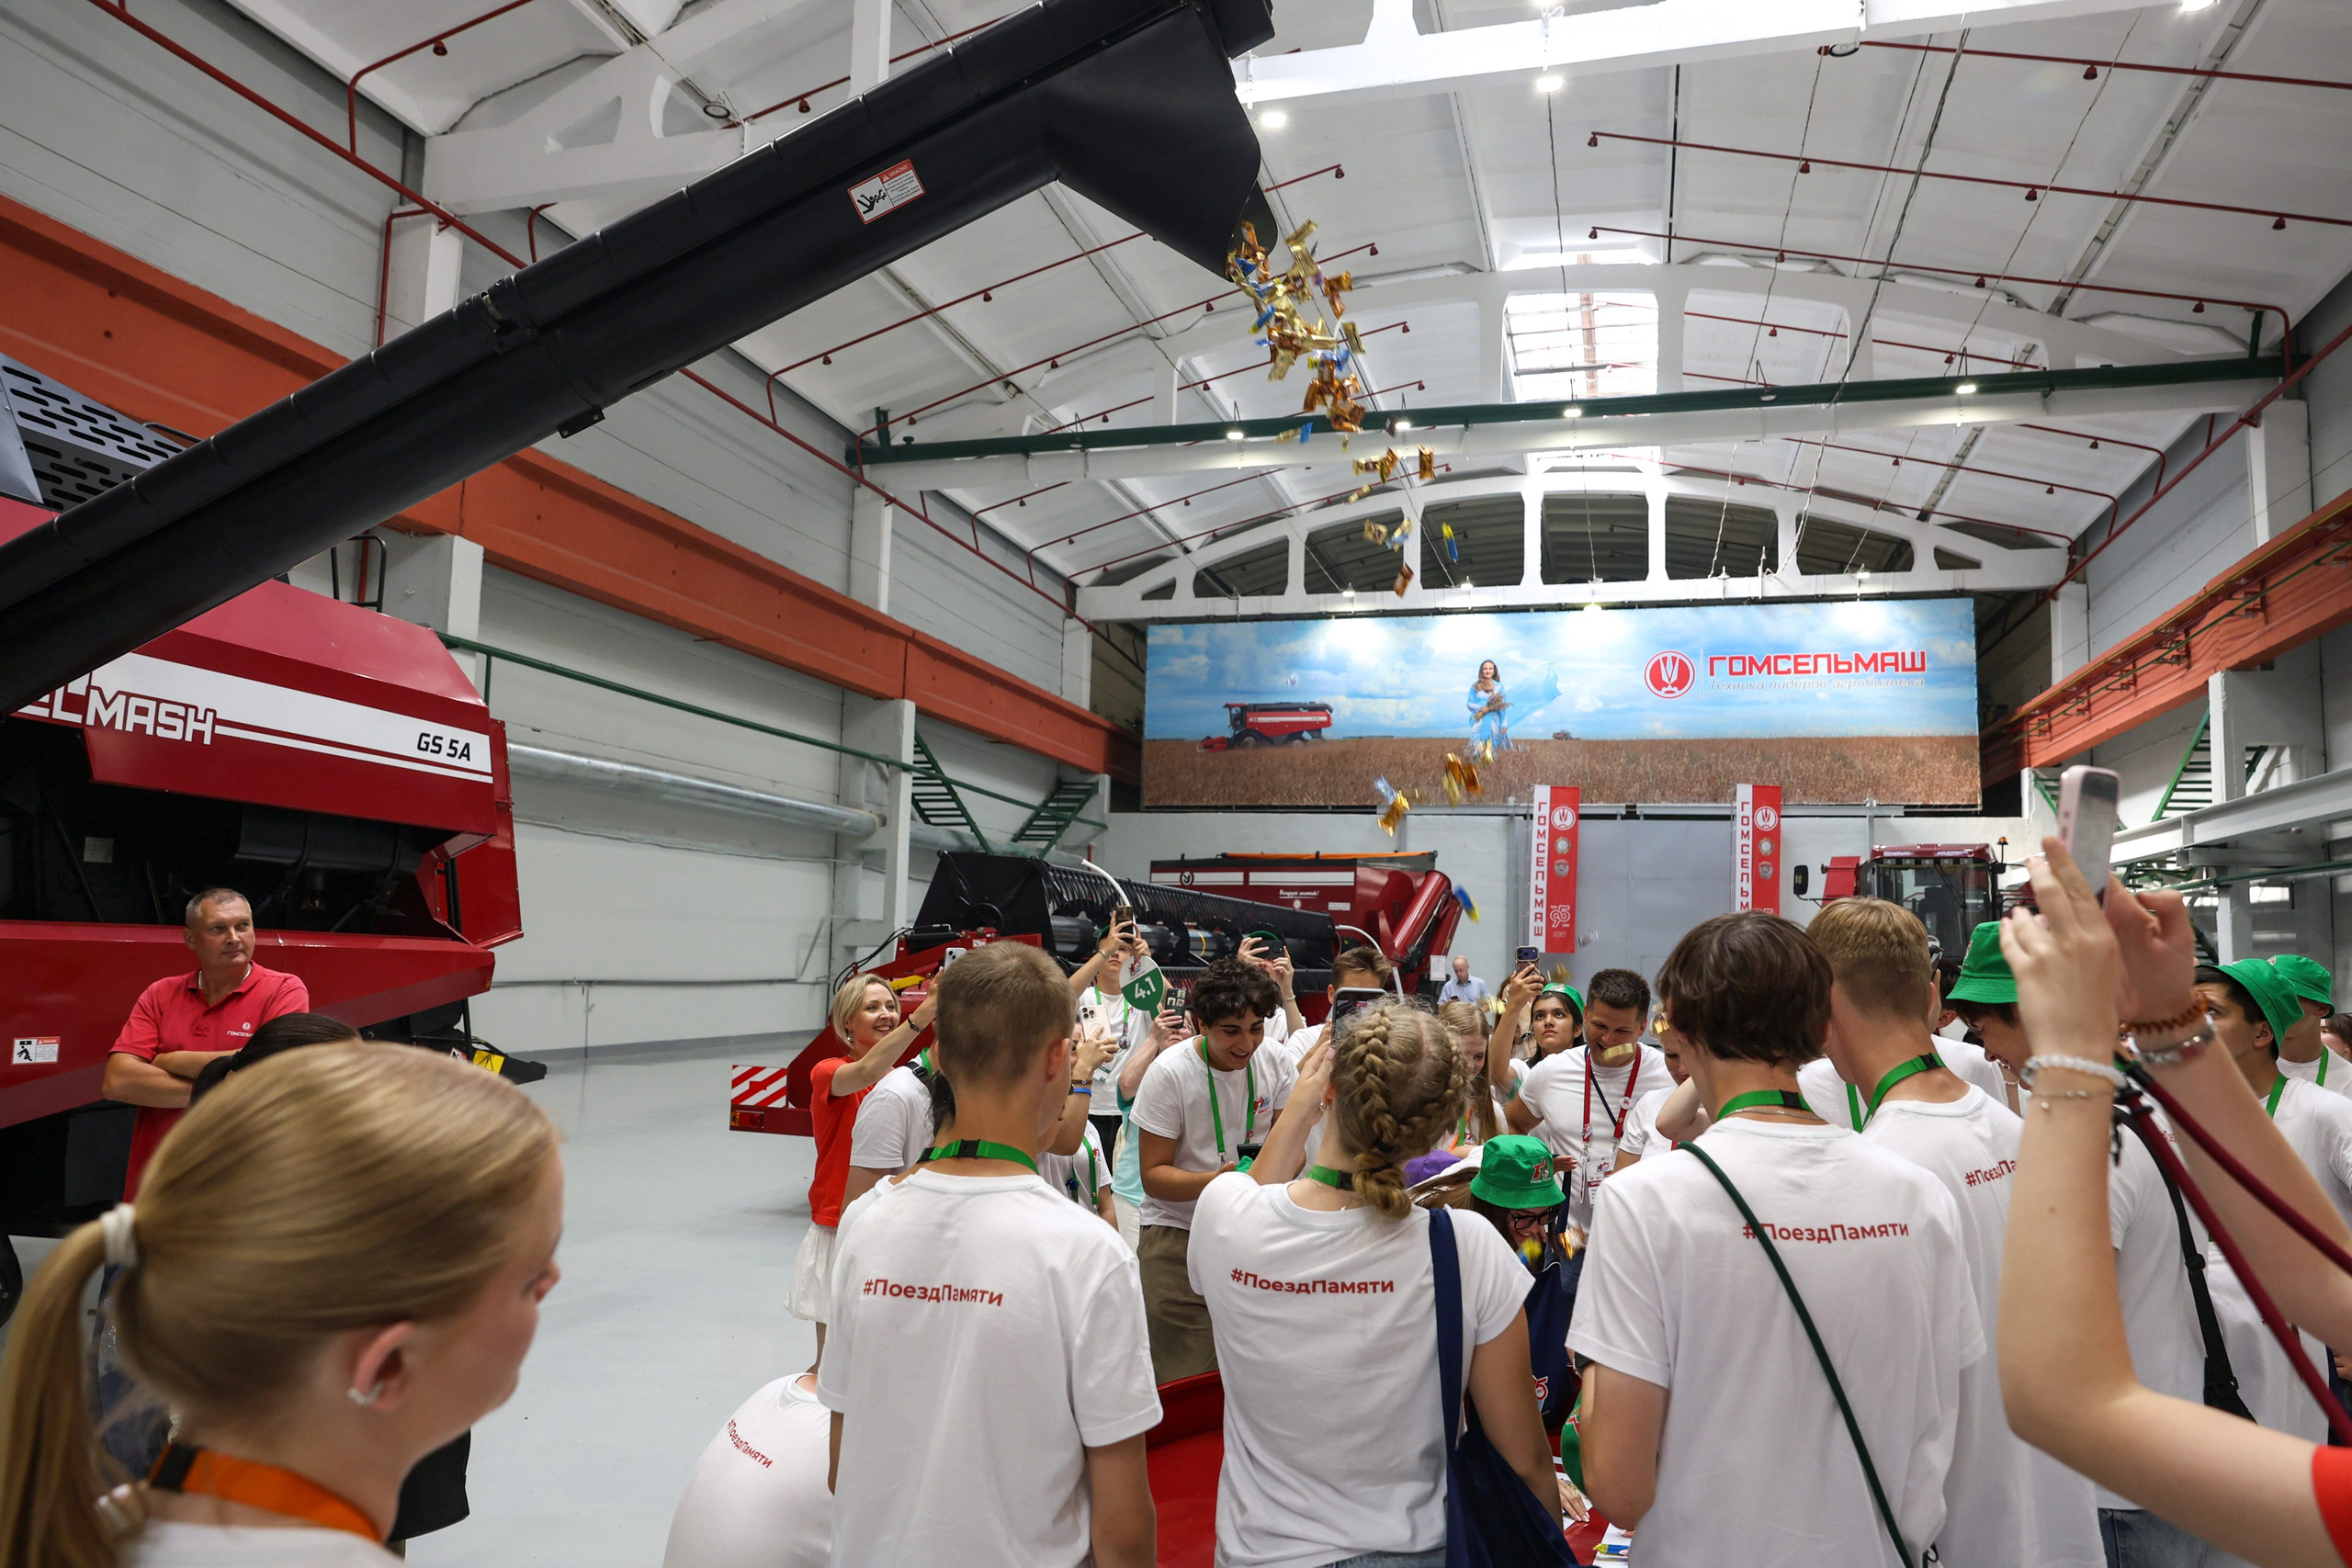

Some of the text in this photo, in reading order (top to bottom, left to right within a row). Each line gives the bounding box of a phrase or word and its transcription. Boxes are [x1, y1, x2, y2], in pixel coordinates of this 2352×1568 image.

[889, 165, 908, 177] ОПАСНО
[1708, 650, 1928, 677] ГОМСЕЛЬМАШ
[1709, 675, 1926, 691] Техника лидеров агробизнеса
[417, 732, 470, 761] GS 5A
[1533, 802, 1547, 937] ГОМСЕЛЬМАШ
[1134, 976, 1157, 999] 4.1
[1742, 1223, 1909, 1244] #ПоездПамяти
[863, 1279, 1004, 1306] #ПоездПамяти
[1230, 1268, 1395, 1294] #ПоездПамяти
[727, 1418, 773, 1469] #ПоездПамяти
